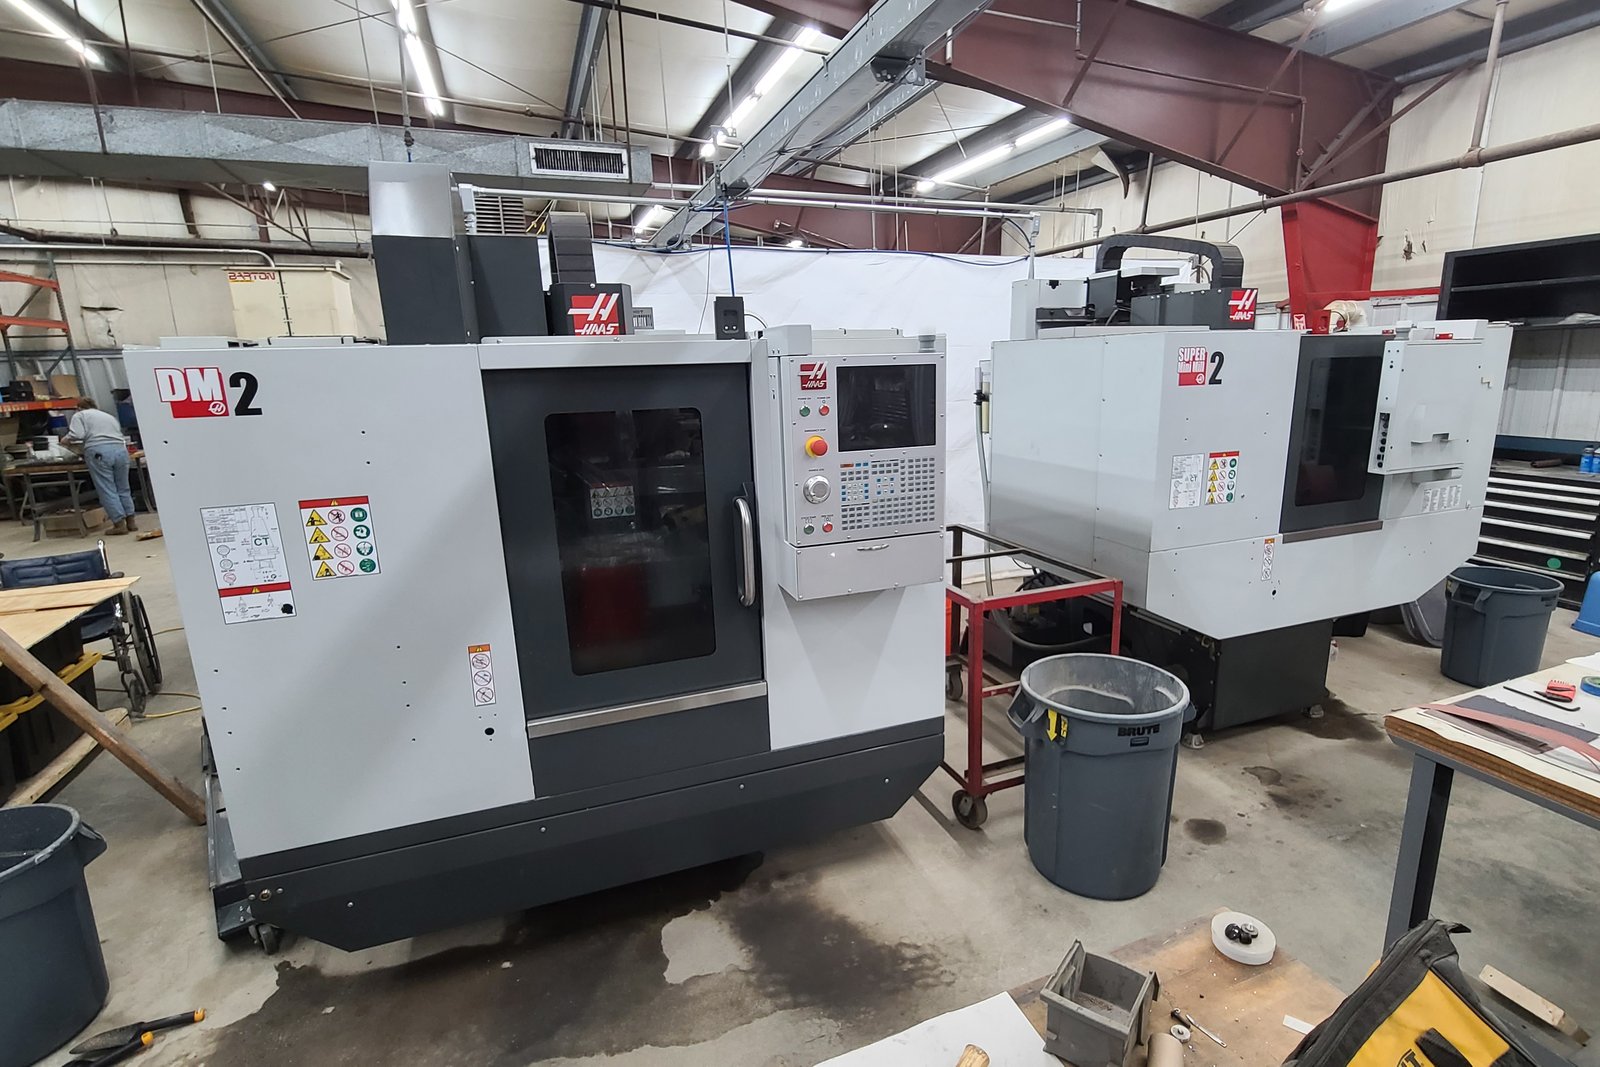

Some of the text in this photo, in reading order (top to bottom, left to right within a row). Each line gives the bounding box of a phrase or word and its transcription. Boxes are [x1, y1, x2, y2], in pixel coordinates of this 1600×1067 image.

[228, 272, 276, 281] BARTON
[1230, 311, 1255, 321] HAAS
[575, 323, 619, 335] HAAS
[1178, 347, 1206, 362] SUPER
[1208, 351, 1225, 385] 2
[154, 367, 263, 416] DM 2
[253, 537, 270, 547] CT
[1117, 724, 1161, 737] BRUTE
